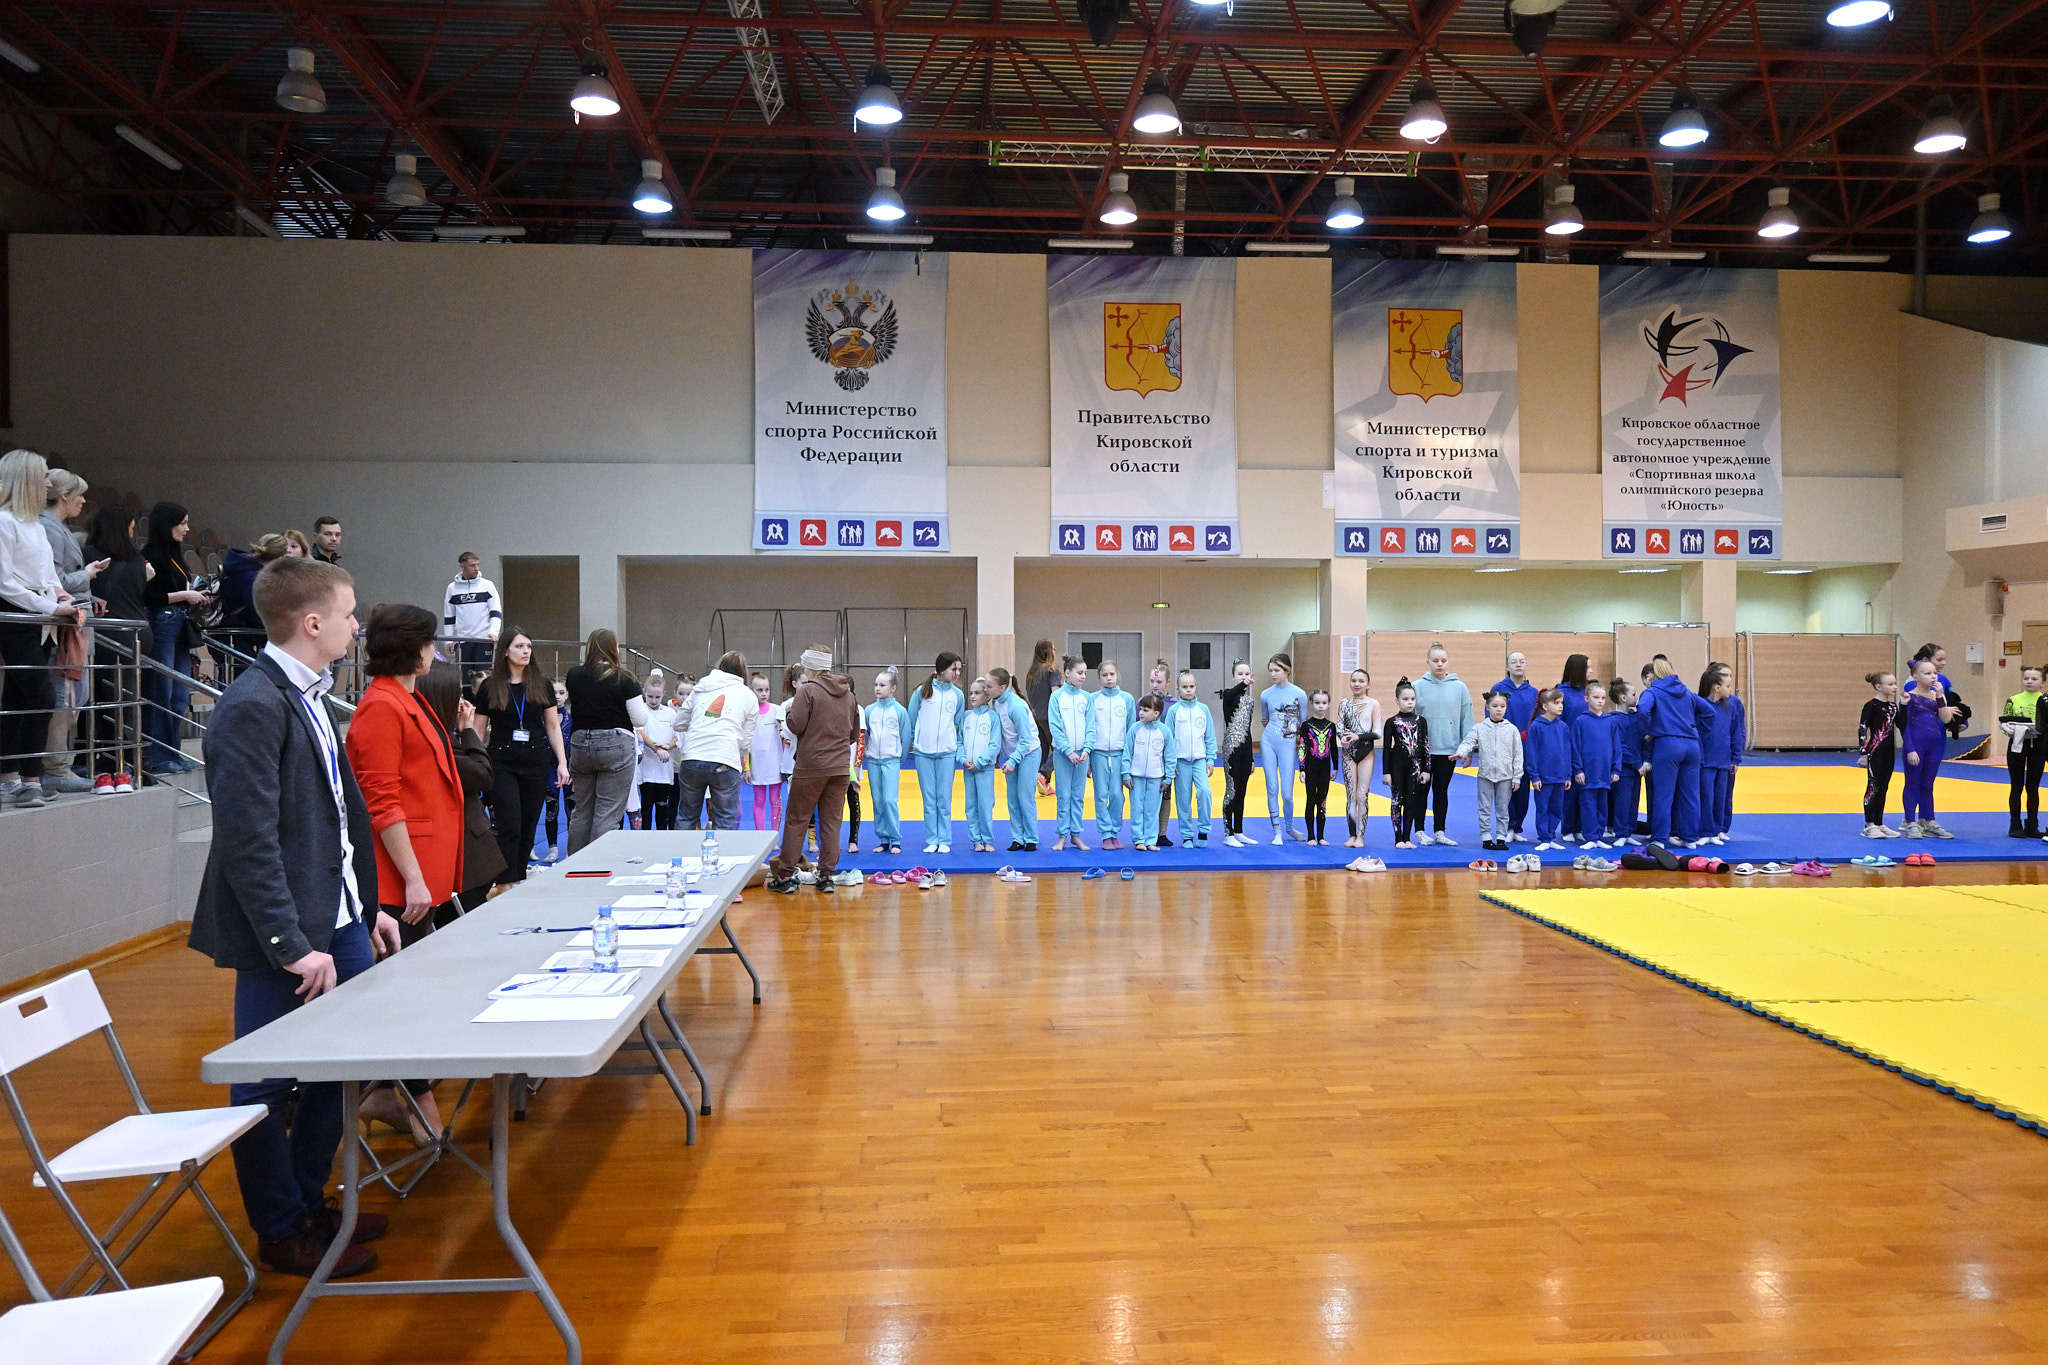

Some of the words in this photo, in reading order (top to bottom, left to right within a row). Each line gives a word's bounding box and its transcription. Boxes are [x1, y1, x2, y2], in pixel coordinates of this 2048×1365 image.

[785, 401, 917, 419] Министерство
[1078, 410, 1210, 427] Правительство
[1622, 417, 1691, 430] Кировское
[1694, 419, 1760, 430] областное
[765, 427, 827, 441] спорта
[832, 425, 937, 440] Российской
[1367, 421, 1486, 438] Министерство
[1096, 434, 1192, 451] Кировской
[1638, 437, 1746, 448] государственное
[800, 447, 902, 465] Федерации
[1355, 446, 1411, 459] спорта
[1416, 448, 1426, 457] и
[1431, 448, 1498, 460] туризма
[1612, 454, 1689, 464] автономное
[1692, 456, 1771, 466] учреждение
[1110, 459, 1180, 472] области
[1382, 466, 1472, 481] Кировской
[1629, 469, 1712, 481] «Спортивная
[1715, 472, 1756, 480] школа
[1395, 488, 1460, 501] области
[1620, 484, 1711, 495] олимпийского
[1715, 487, 1764, 498] резерва
[1661, 500, 1724, 511] «Юность»
[460, 593, 477, 601] EA7
